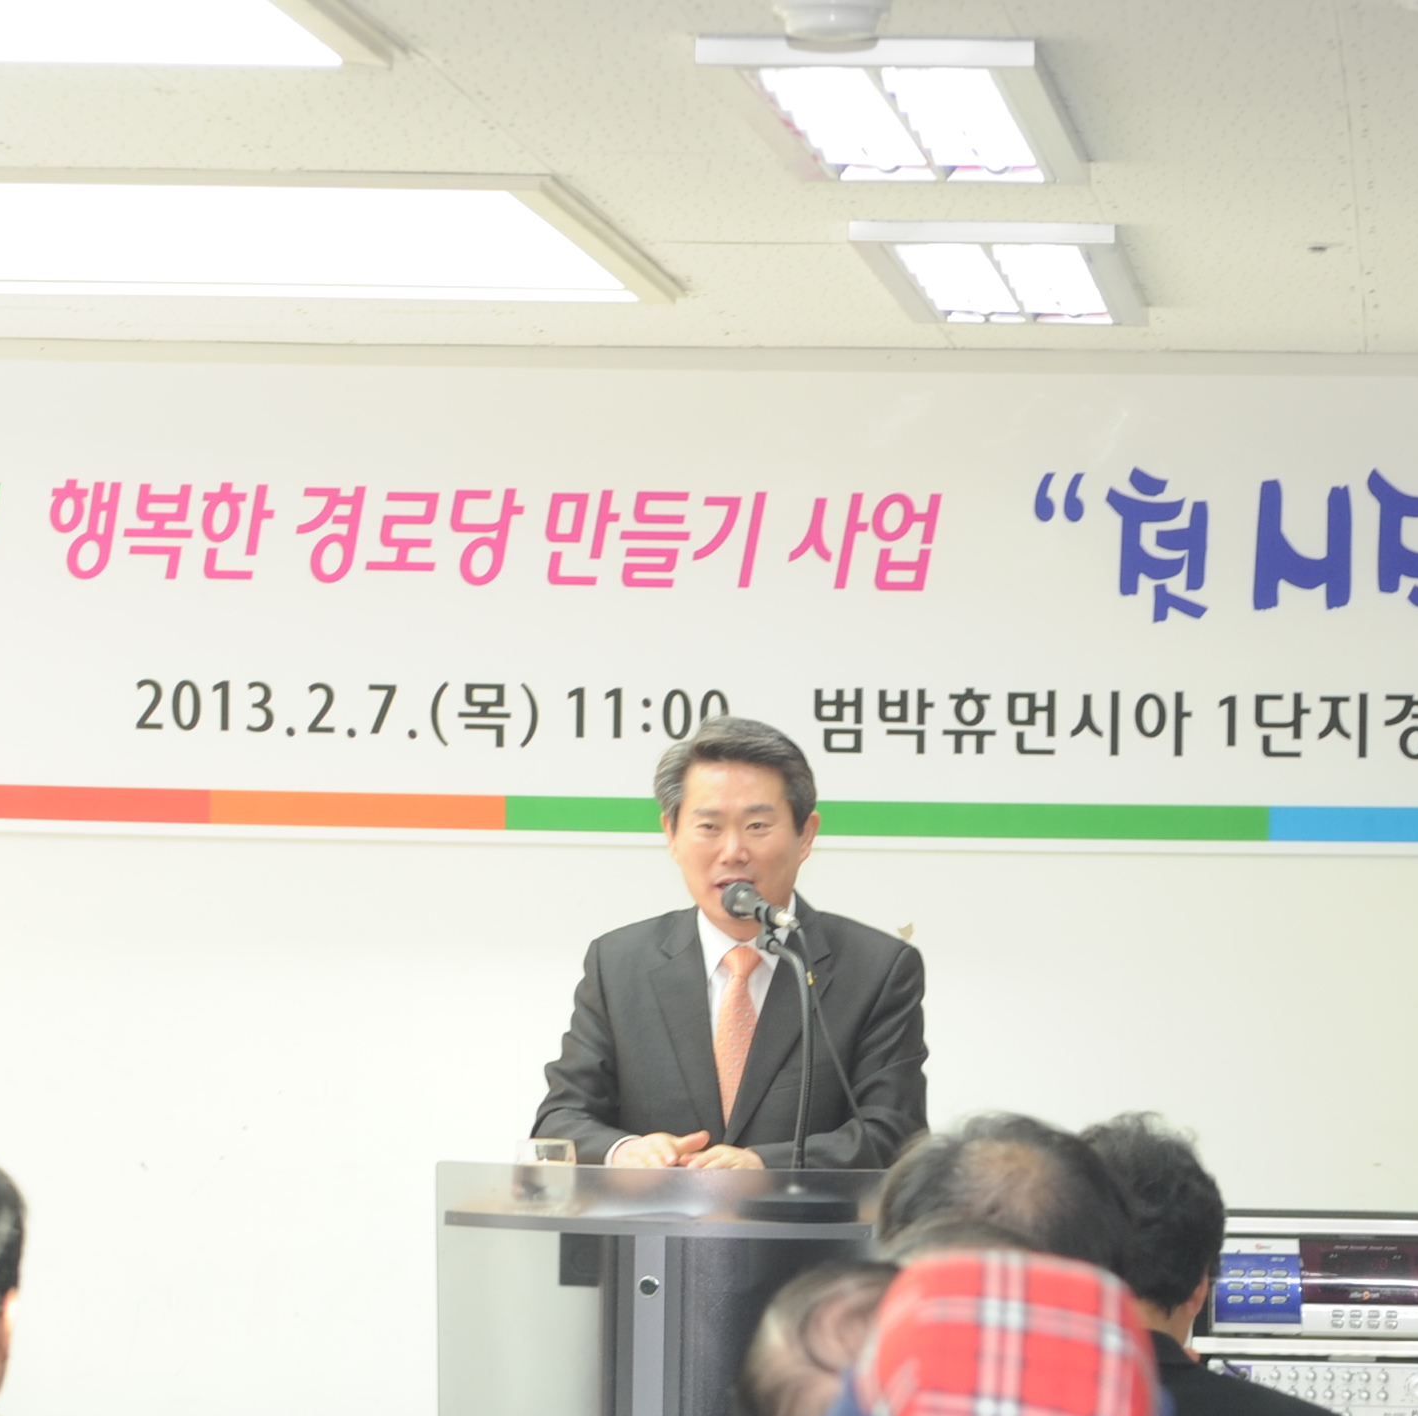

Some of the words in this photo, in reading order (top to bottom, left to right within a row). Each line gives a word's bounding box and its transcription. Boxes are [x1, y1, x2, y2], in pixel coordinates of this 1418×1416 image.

[49, 479, 277, 582] 행복한
[296, 486, 526, 588] 경로당
[545, 490, 769, 589] 만들기
[788, 493, 944, 593] 사업
[136, 679, 541, 749] 2013.2.7.(목)
[813, 687, 1194, 757] 범박휴먼시아
